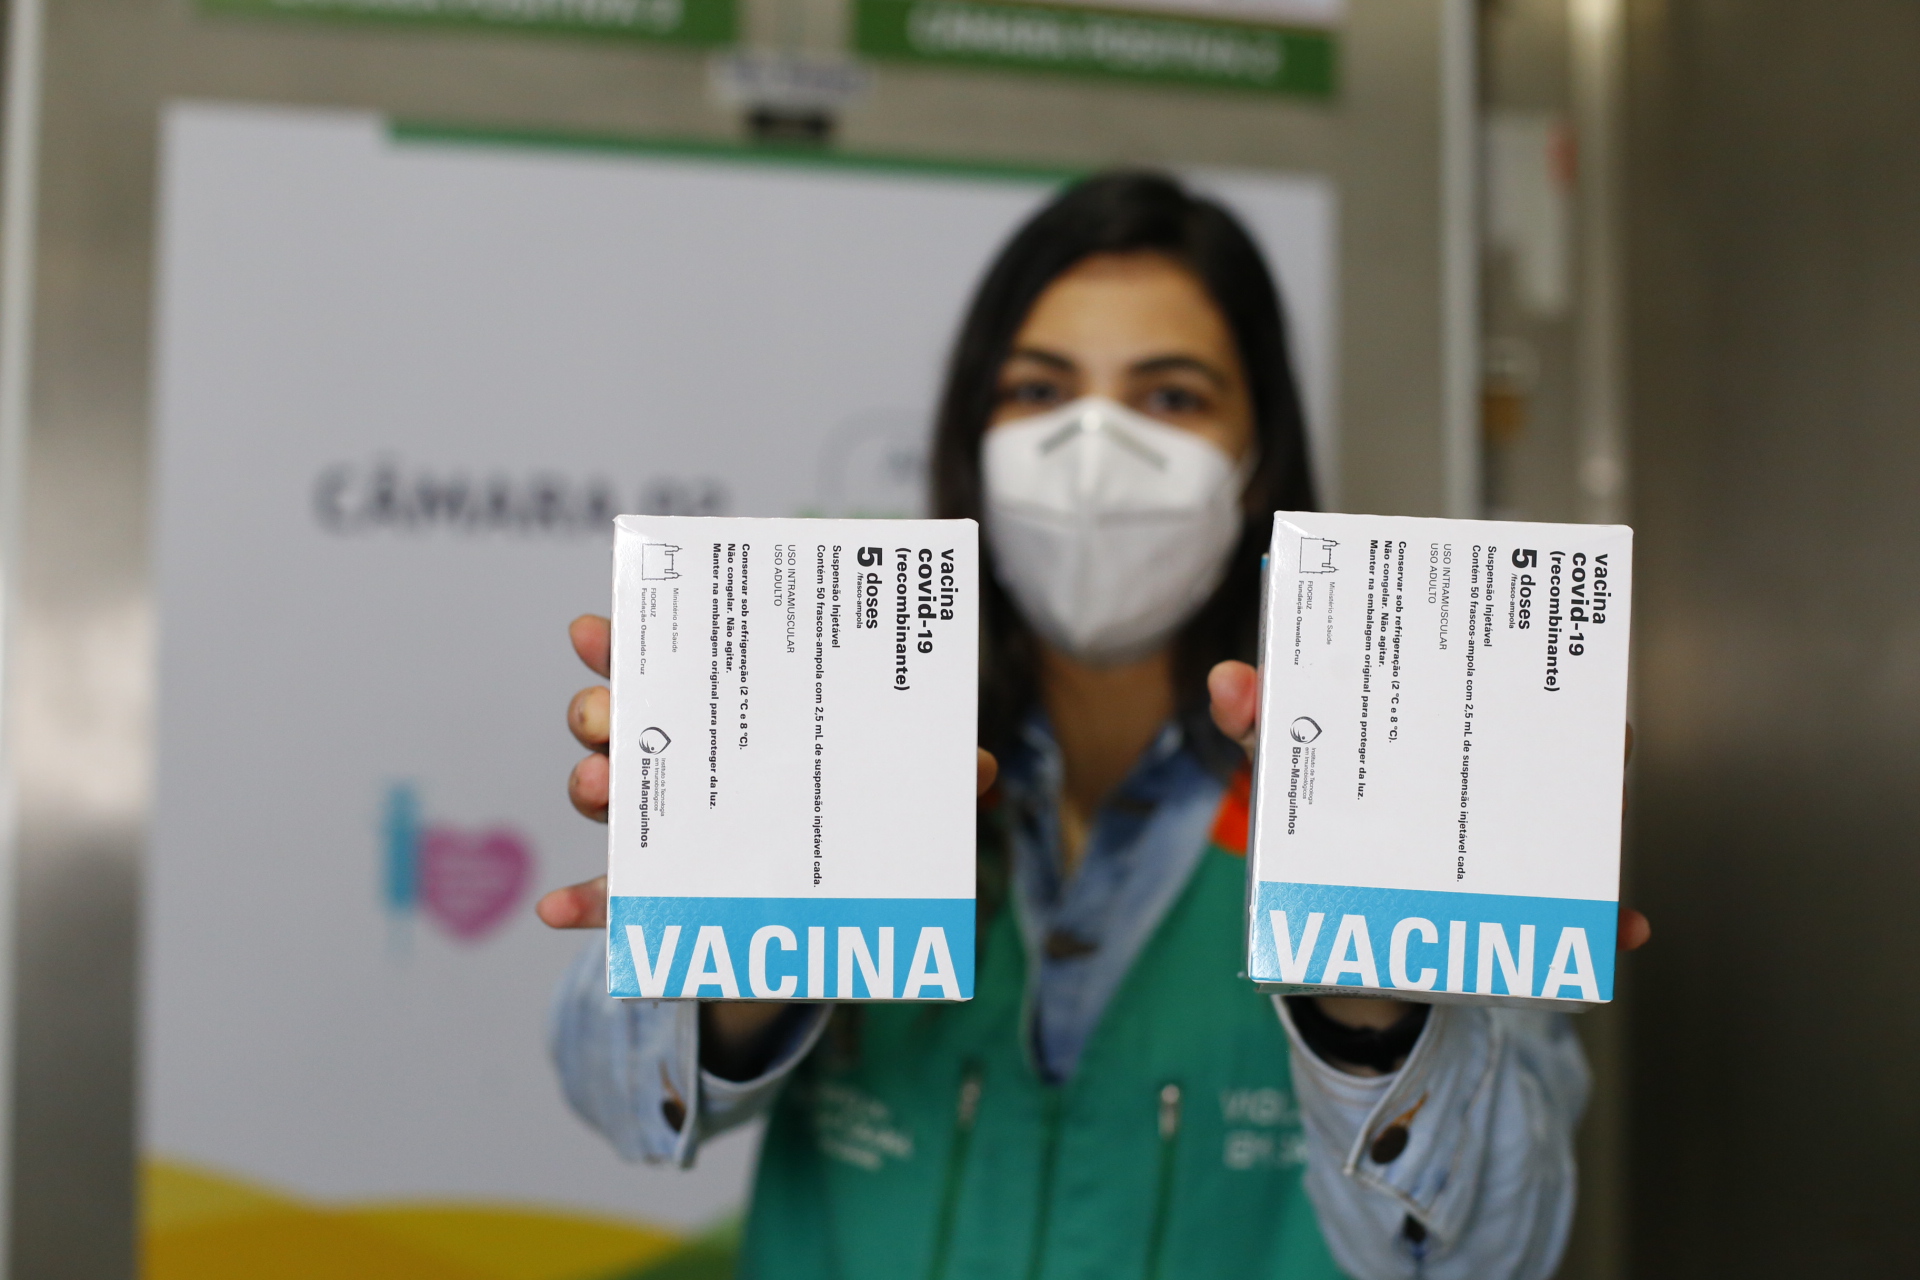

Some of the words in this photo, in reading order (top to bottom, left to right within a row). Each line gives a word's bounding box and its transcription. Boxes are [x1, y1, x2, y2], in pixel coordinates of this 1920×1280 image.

[712, 543, 722, 580] Manter
[727, 543, 736, 564] Não
[774, 544, 783, 566] USO
[787, 544, 796, 566] USO
[816, 544, 826, 584] Contém
[857, 546, 883, 567] 5
[1369, 539, 1378, 575] Manter
[1384, 540, 1393, 560] Não
[1396, 541, 1407, 592] Conservar
[1430, 542, 1439, 564] USO
[1442, 543, 1452, 565] USO
[1471, 544, 1482, 584] Contém
[1512, 548, 1538, 569] 5
[741, 543, 750, 596] Conservar
[774, 567, 783, 607] ADULTO
[830, 545, 842, 602] Suspensão
[940, 548, 959, 620] vacina
[1368, 578, 1374, 590] na
[1380, 563, 1390, 609] congelar.
[1428, 565, 1438, 604] ADULTO
[1485, 546, 1497, 602] Suspensão
[640, 587, 648, 623] Fundação
[712, 582, 719, 595] na
[725, 566, 735, 614] congelar.
[816, 587, 826, 600] 50
[855, 572, 864, 629] /frasco-ampola
[866, 572, 883, 629] doses
[917, 548, 937, 654] covid-19
[1296, 580, 1304, 615] Fundação
[1306, 580, 1314, 610] FIOCRUZ
[1328, 581, 1336, 614] Ministério
[1395, 594, 1404, 613] sob
[1470, 586, 1480, 599] 50
[1508, 573, 1518, 629] /frasco-ampola
[1518, 574, 1536, 630] doses
[1568, 552, 1590, 656] covid-19
[1592, 553, 1611, 624] vacina
[741, 598, 750, 617] sob
[786, 568, 796, 653] INTRAMUSCULAR
[893, 548, 912, 691] (recombinante)
[1327, 614, 1334, 624] da
[1364, 593, 1375, 651] embalagem
[1380, 612, 1389, 632] Não
[1439, 567, 1451, 650] INTRAMUSCULAR
[1544, 550, 1566, 692] (recombinante)
[672, 622, 678, 631] da
[710, 598, 720, 657] embalagem
[726, 617, 735, 638] Não
[814, 602, 826, 679] frascos-ampola
[830, 604, 841, 648] Injetável
[1295, 616, 1303, 648] Oswaldo
[1326, 624, 1334, 645] Saúde
[1466, 601, 1479, 677] frascos-ampola
[1483, 604, 1494, 647] Injetável
[724, 640, 734, 673] agitar.
[738, 620, 749, 683] refrigeração
[1378, 635, 1388, 667] agitar.
[1391, 616, 1403, 678] refrigeração
[709, 660, 720, 700] original
[739, 686, 748, 696] (2
[1362, 654, 1372, 693] original
[1391, 680, 1400, 690] (2
[709, 703, 717, 726] para
[814, 706, 824, 722] 2,5
[1360, 695, 1368, 718] para
[1464, 704, 1474, 719] 2,5
[740, 722, 748, 730] 8
[815, 724, 824, 741] mL
[1358, 720, 1368, 764] proteger
[1464, 721, 1473, 737] mL
[708, 728, 718, 773] proteger
[814, 743, 824, 756] de
[1463, 740, 1472, 752] de
[660, 780, 666, 788] de
[710, 776, 718, 788] da
[812, 758, 823, 813] suspensão
[1309, 768, 1315, 776] de
[1358, 767, 1367, 780] da
[1460, 755, 1470, 808] suspensão
[638, 758, 651, 848] Bio-Manguinhos
[710, 792, 718, 810] luz.
[1287, 746, 1302, 835] Bio-Manguinhos
[1307, 777, 1316, 805] Tecnologia
[1357, 782, 1366, 800] luz.
[812, 816, 823, 858] injetável
[1458, 811, 1469, 854] injetável
[813, 861, 822, 888] cada.
[1456, 856, 1466, 882] cada.
[625, 925, 962, 998] VACINA
[1269, 910, 1600, 1000] VACINA
